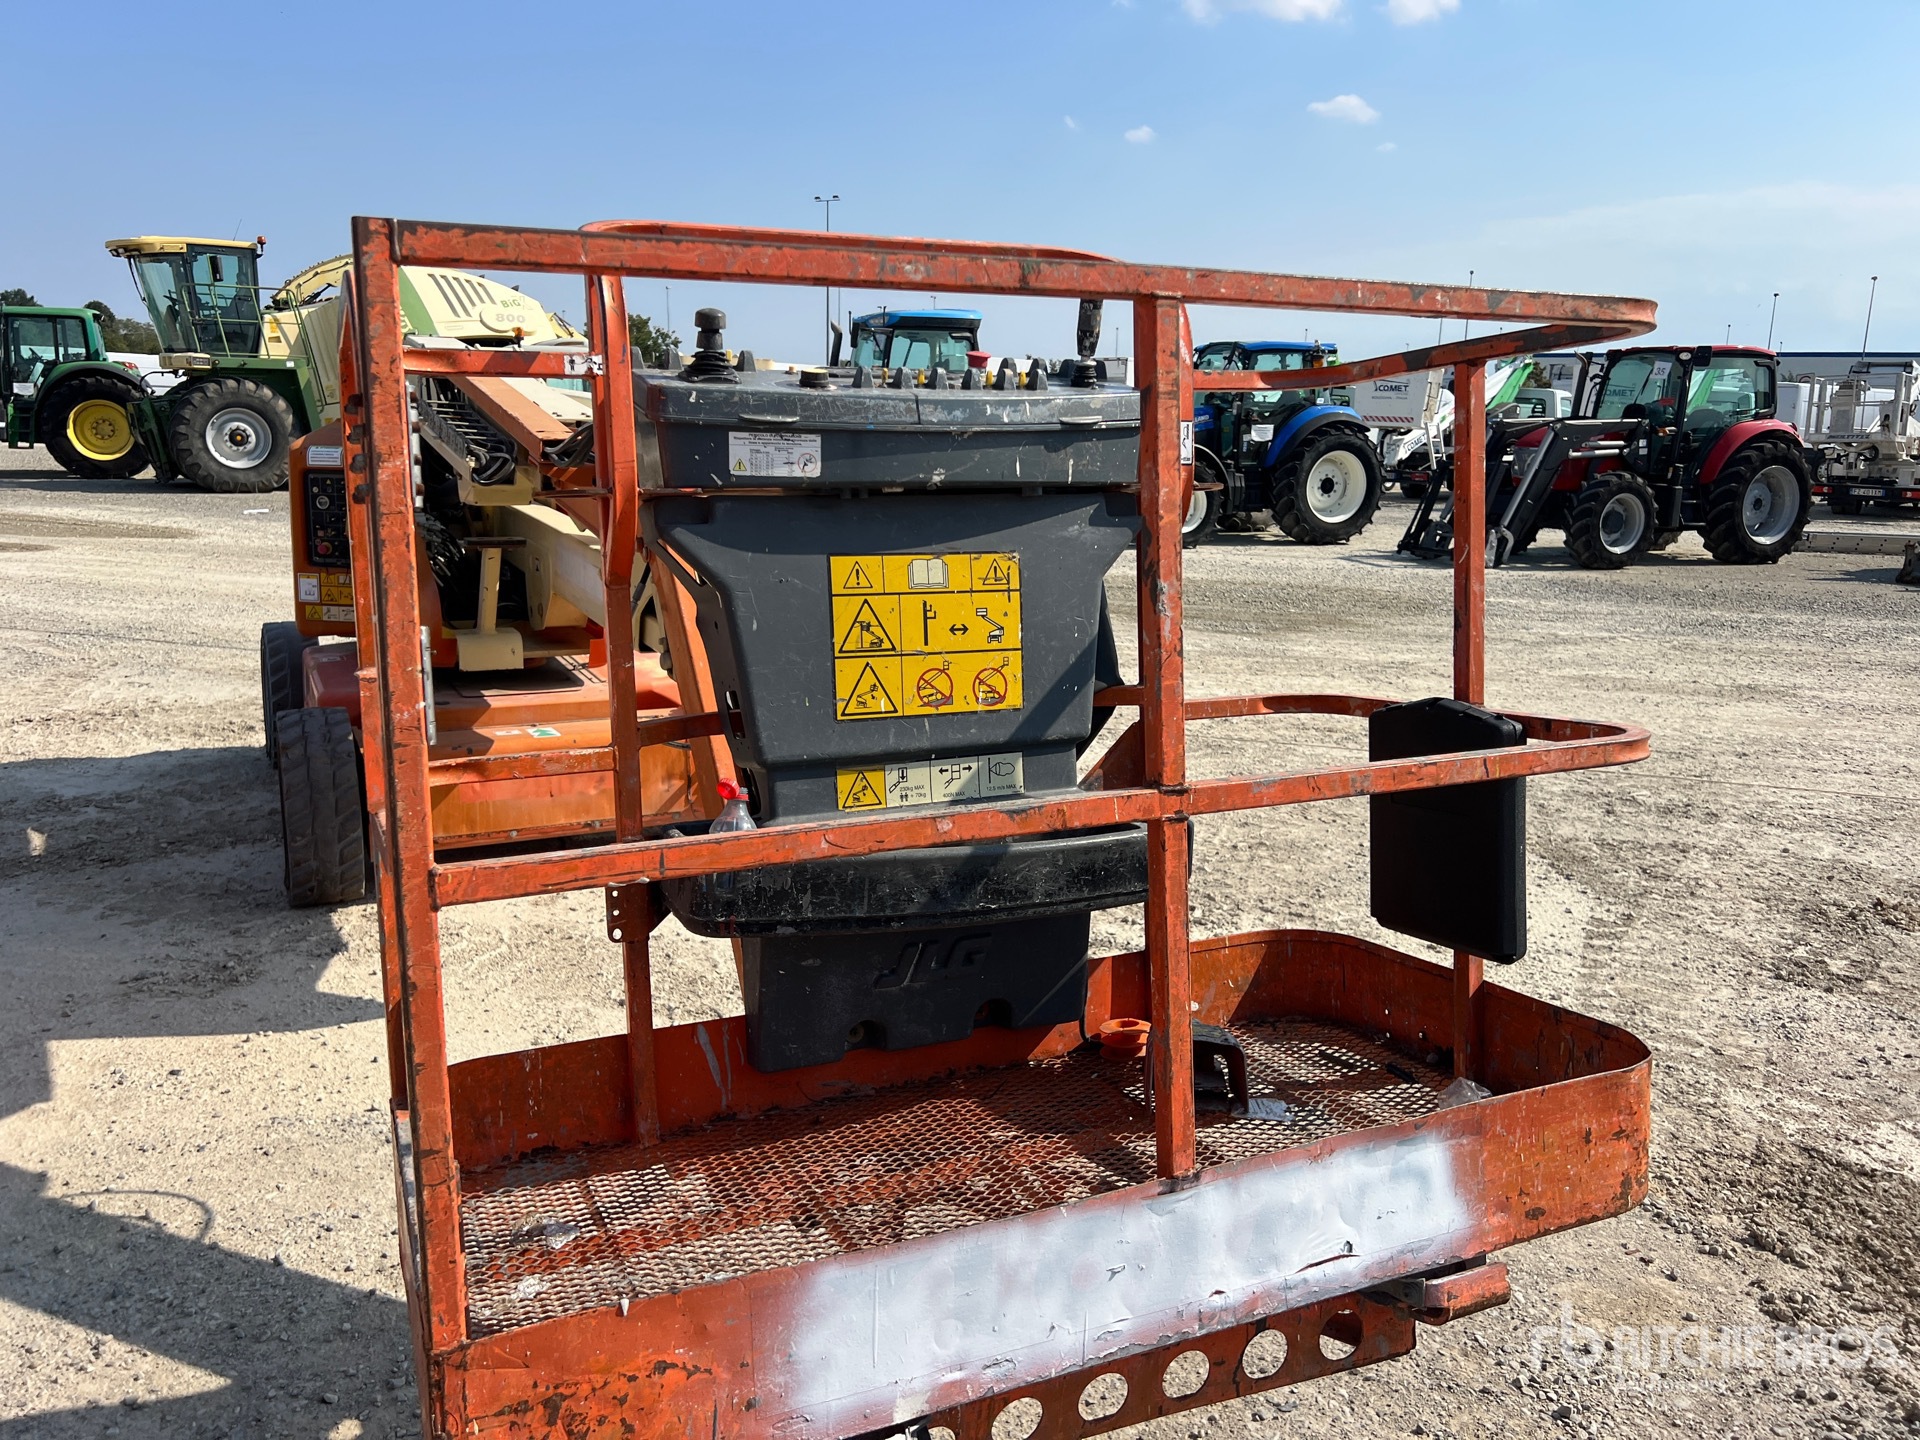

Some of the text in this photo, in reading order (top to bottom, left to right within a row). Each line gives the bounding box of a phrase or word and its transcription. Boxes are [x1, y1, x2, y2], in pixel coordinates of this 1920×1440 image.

[495, 313, 525, 323] 800
[1655, 367, 1666, 376] 35
[872, 932, 992, 991] JLG
